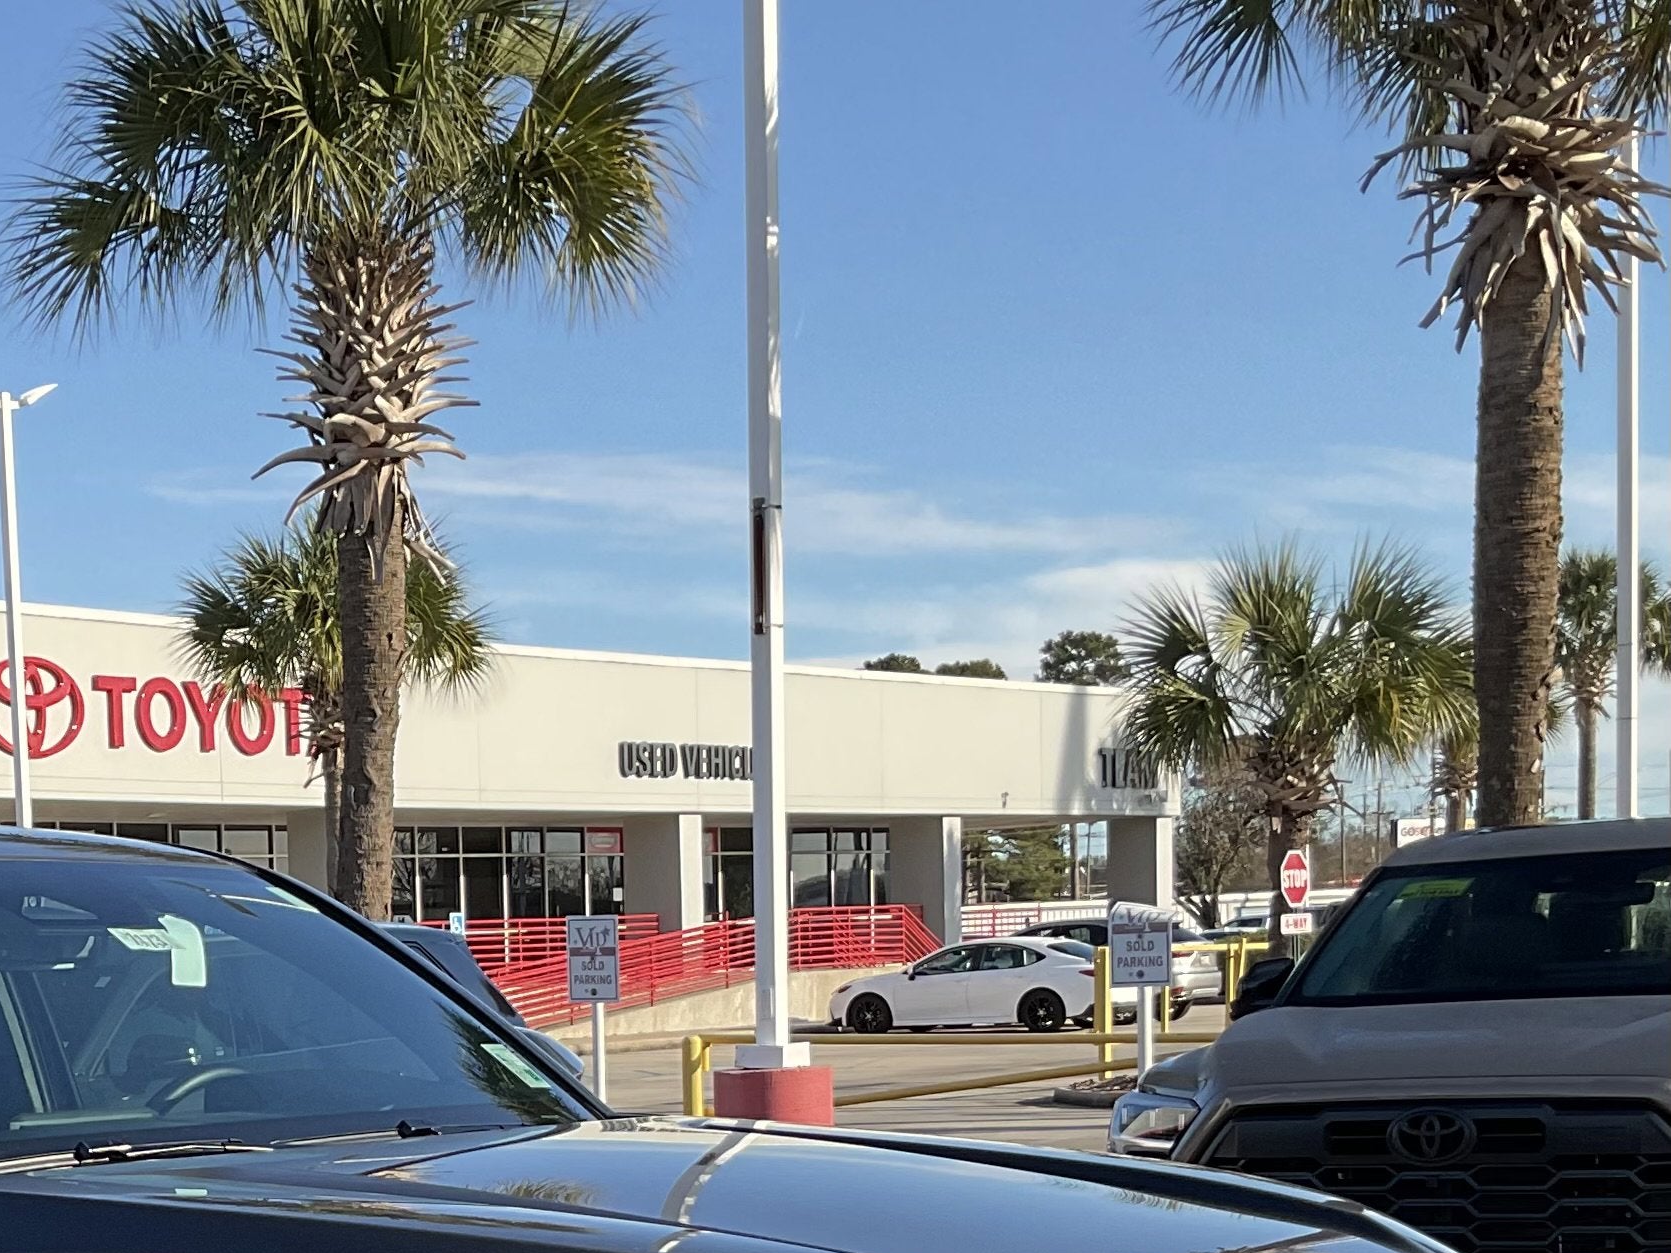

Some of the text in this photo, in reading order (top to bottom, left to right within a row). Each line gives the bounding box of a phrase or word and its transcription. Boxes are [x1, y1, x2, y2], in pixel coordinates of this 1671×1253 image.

[91, 675, 316, 758] TOYOT
[618, 741, 754, 781] USED VEHICL
[1283, 869, 1307, 888] STOP
[1285, 917, 1307, 930] 4-WAY
[1126, 940, 1155, 952] SOLD
[581, 960, 605, 971] SOLD
[1117, 956, 1164, 968] PARKING
[574, 975, 612, 985] PARKING
